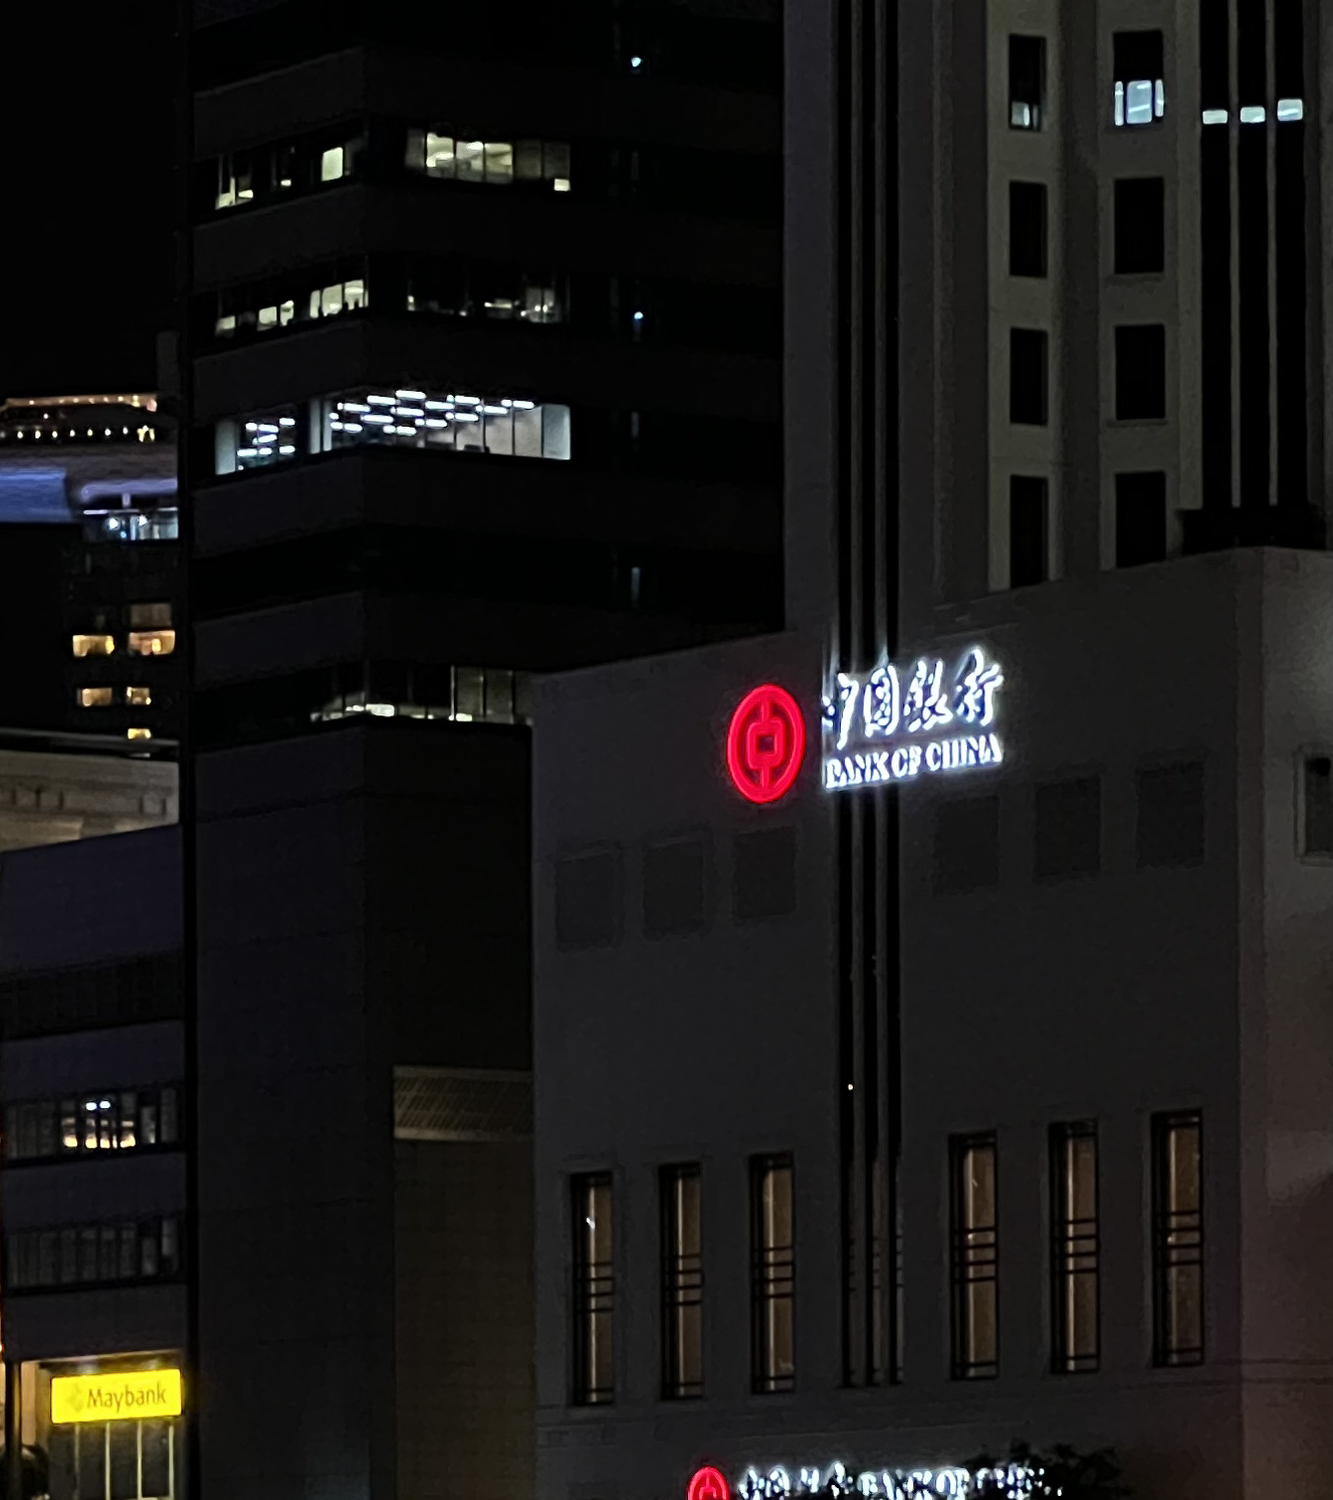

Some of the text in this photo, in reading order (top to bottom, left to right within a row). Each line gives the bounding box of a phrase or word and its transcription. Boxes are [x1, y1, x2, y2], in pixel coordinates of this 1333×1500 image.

[826, 733, 1004, 789] BANK OF CHINA
[87, 1382, 167, 1413] Maybank
